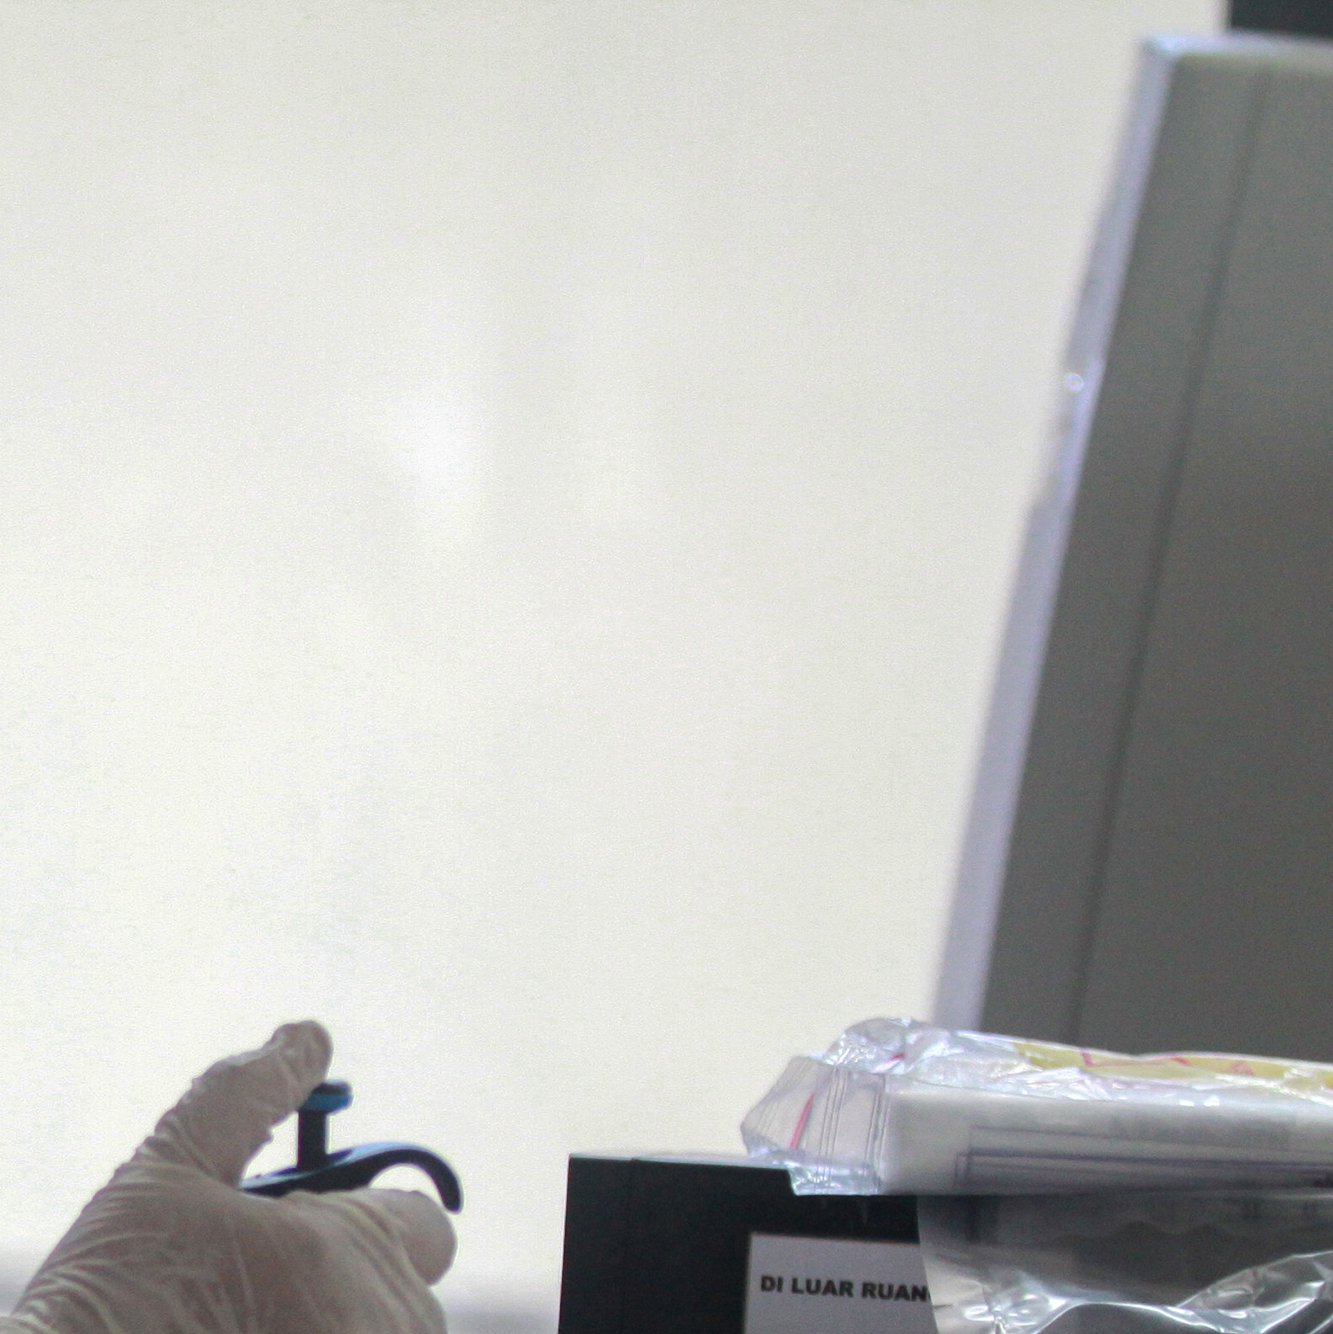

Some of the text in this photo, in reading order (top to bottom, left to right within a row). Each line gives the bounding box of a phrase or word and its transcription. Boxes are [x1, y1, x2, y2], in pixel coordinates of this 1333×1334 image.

[760, 1274, 931, 1303] DI LUAR RUAN
